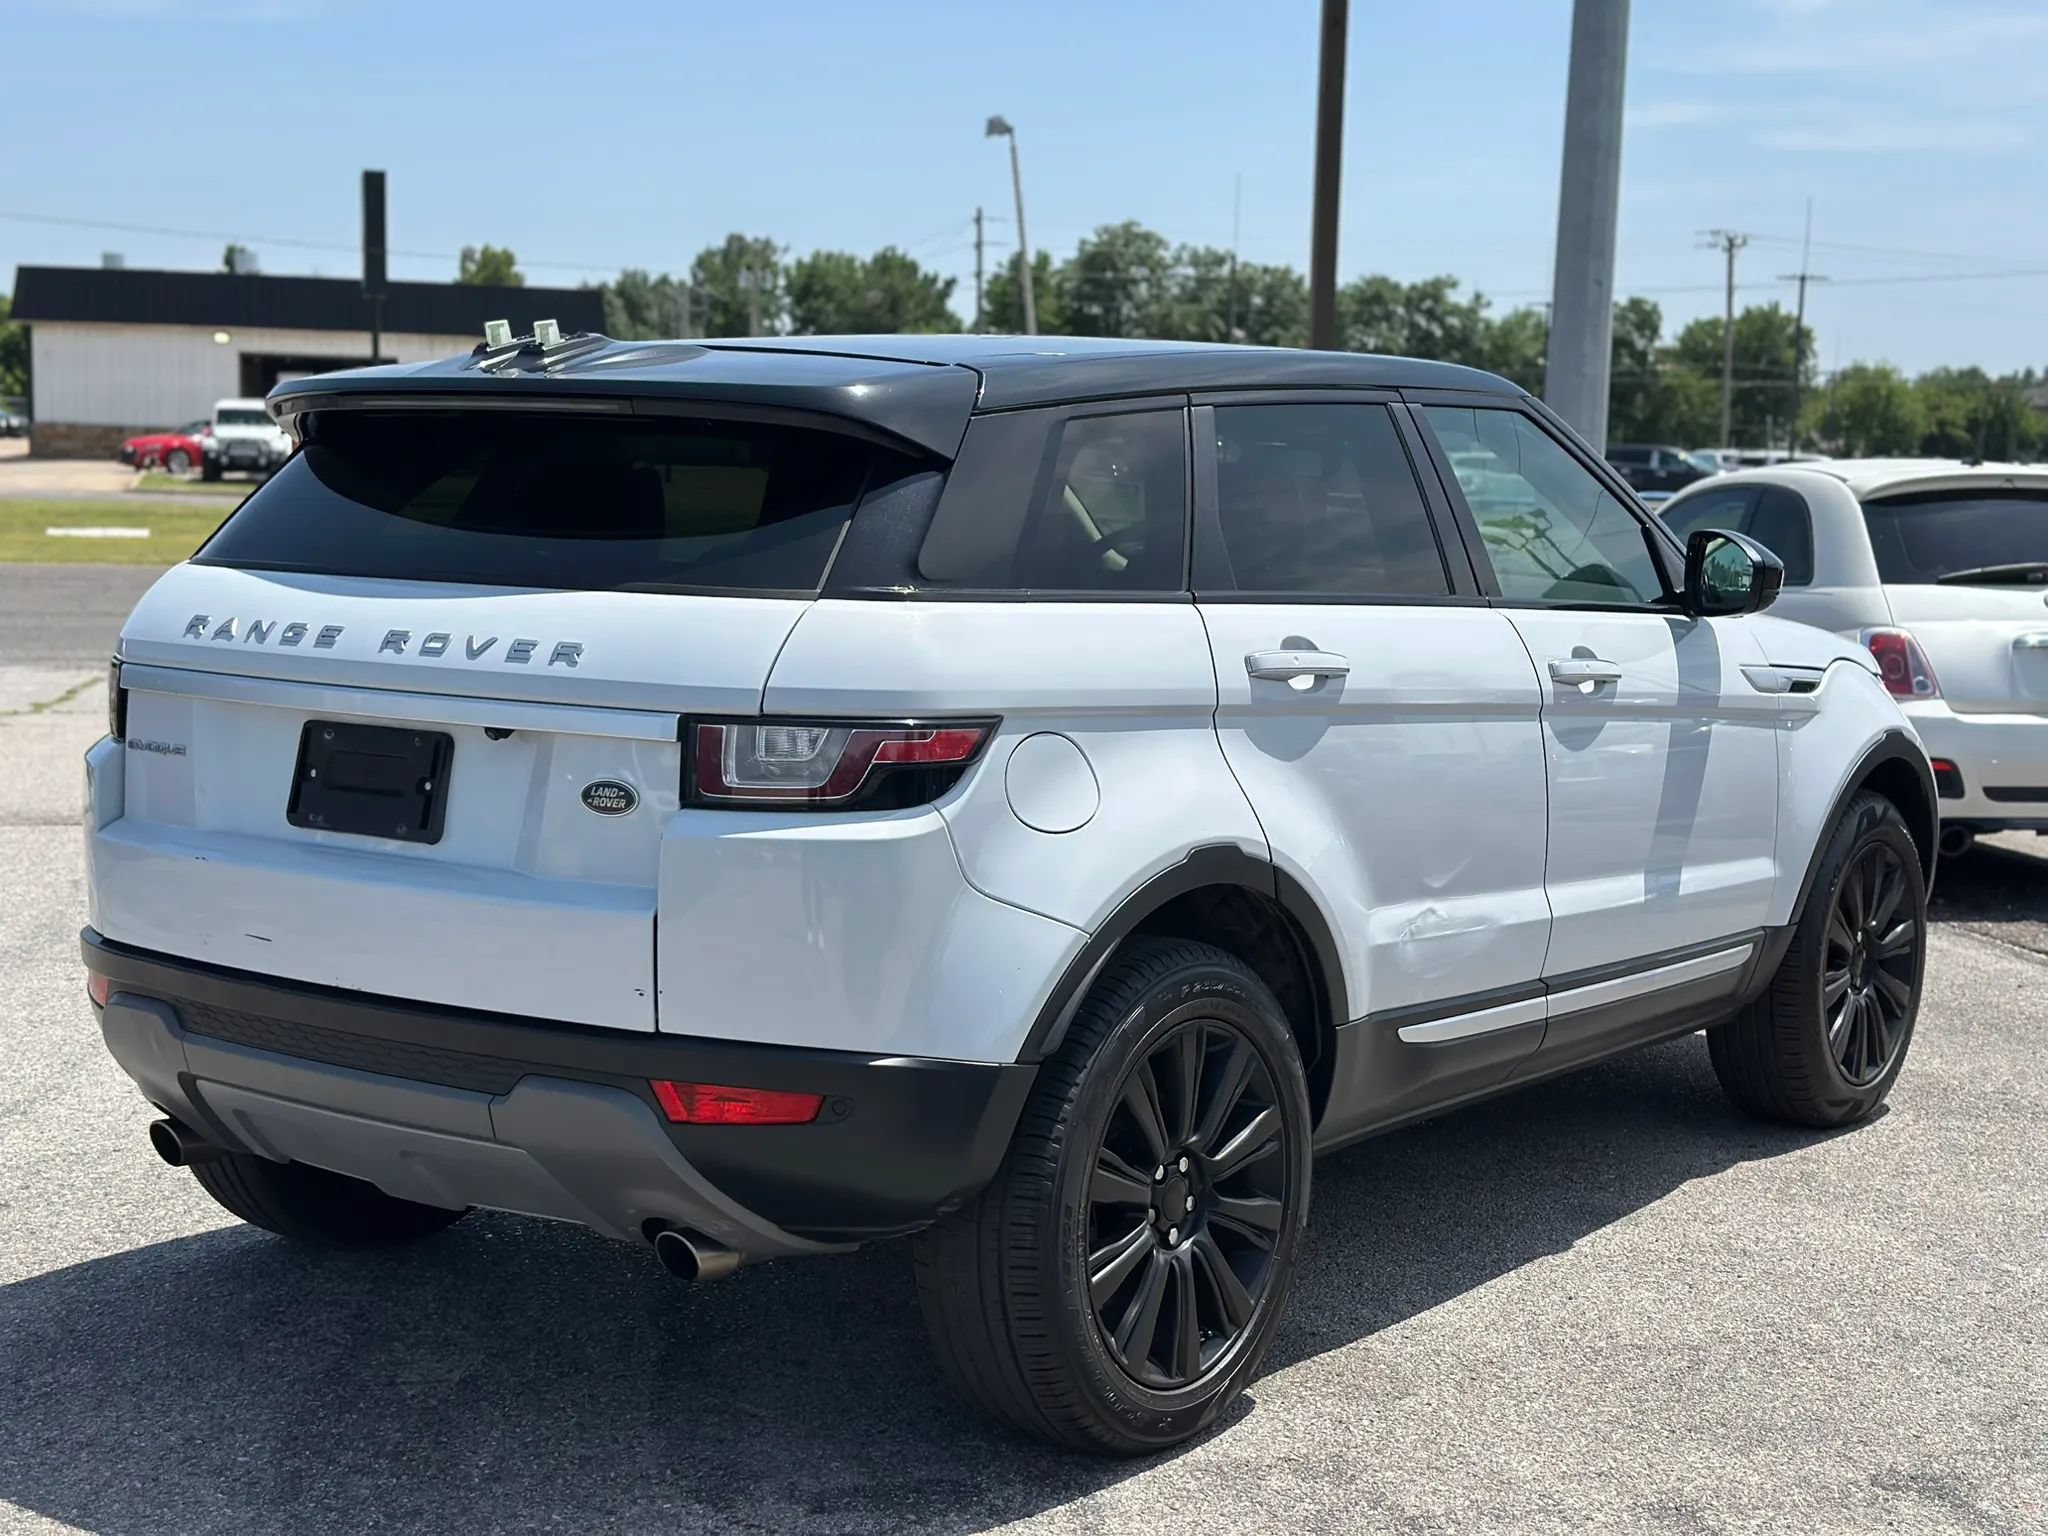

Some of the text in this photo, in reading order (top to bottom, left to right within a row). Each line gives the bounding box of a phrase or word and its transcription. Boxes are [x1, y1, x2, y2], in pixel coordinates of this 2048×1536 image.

[183, 614, 585, 667] RANGE ROVER
[590, 786, 618, 797] LAND
[592, 796, 626, 808] ROVER
